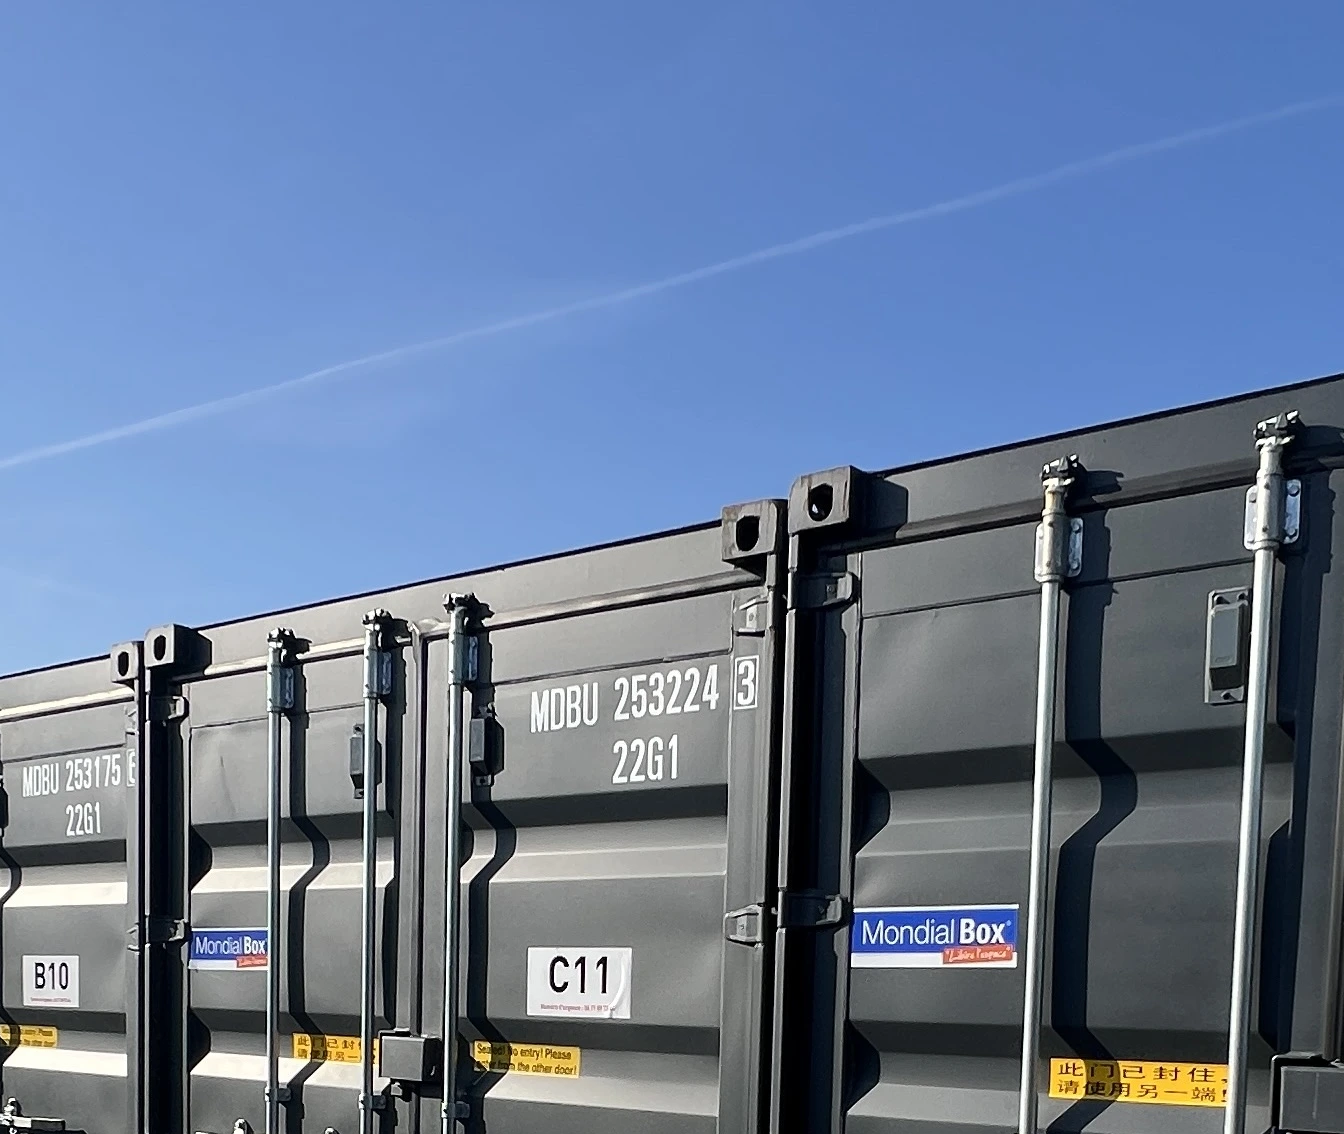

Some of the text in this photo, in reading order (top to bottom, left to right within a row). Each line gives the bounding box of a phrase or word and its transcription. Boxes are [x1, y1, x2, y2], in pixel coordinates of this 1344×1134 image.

[530, 660, 756, 734] MDBU 253224 3
[22, 763, 60, 798] MDBU
[65, 754, 121, 792] 253175
[611, 734, 679, 785] 22G1
[65, 801, 101, 837] 22G1
[34, 962, 69, 990] B10
[549, 955, 608, 994] C11
[517, 1061, 530, 1072] the
[531, 1062, 553, 1073] other
[554, 1064, 576, 1075] door!
[520, 1047, 543, 1060] entry!
[545, 1048, 572, 1061] Please
